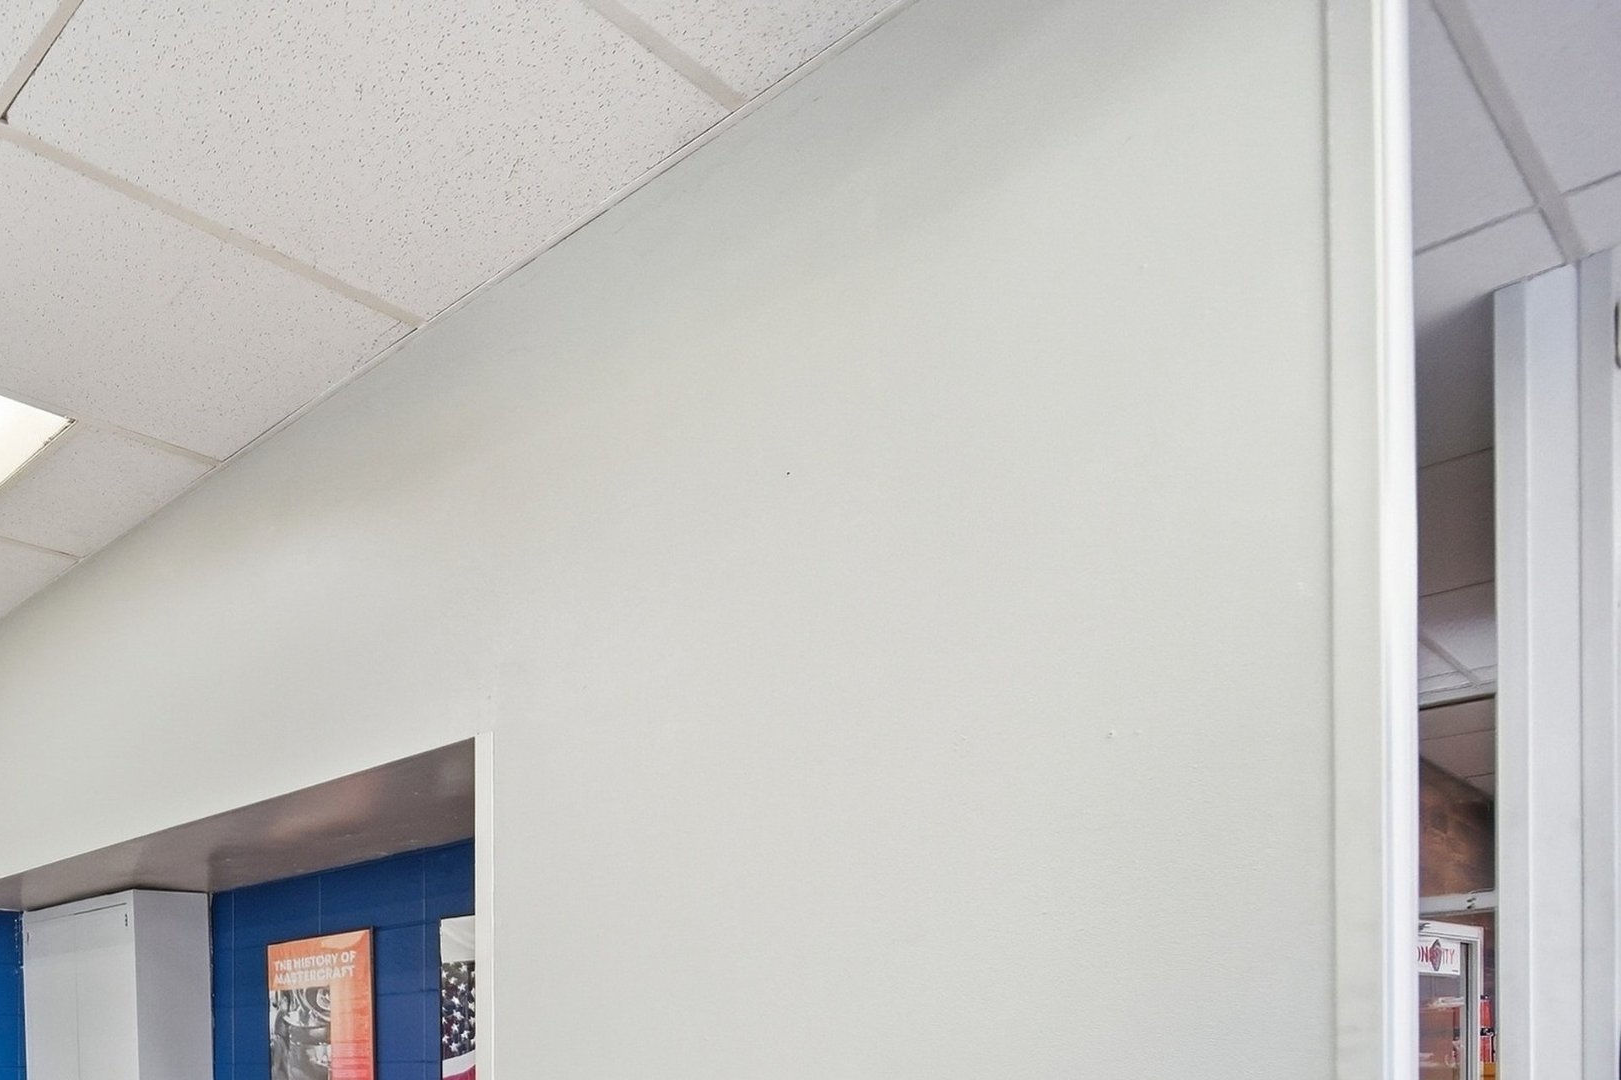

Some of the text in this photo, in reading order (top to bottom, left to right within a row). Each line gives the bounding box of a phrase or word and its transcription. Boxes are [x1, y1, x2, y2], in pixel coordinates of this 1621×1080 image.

[294, 953, 338, 970] HISTORY
[340, 950, 357, 963] OF
[274, 965, 355, 985] MASTERCRAFT
